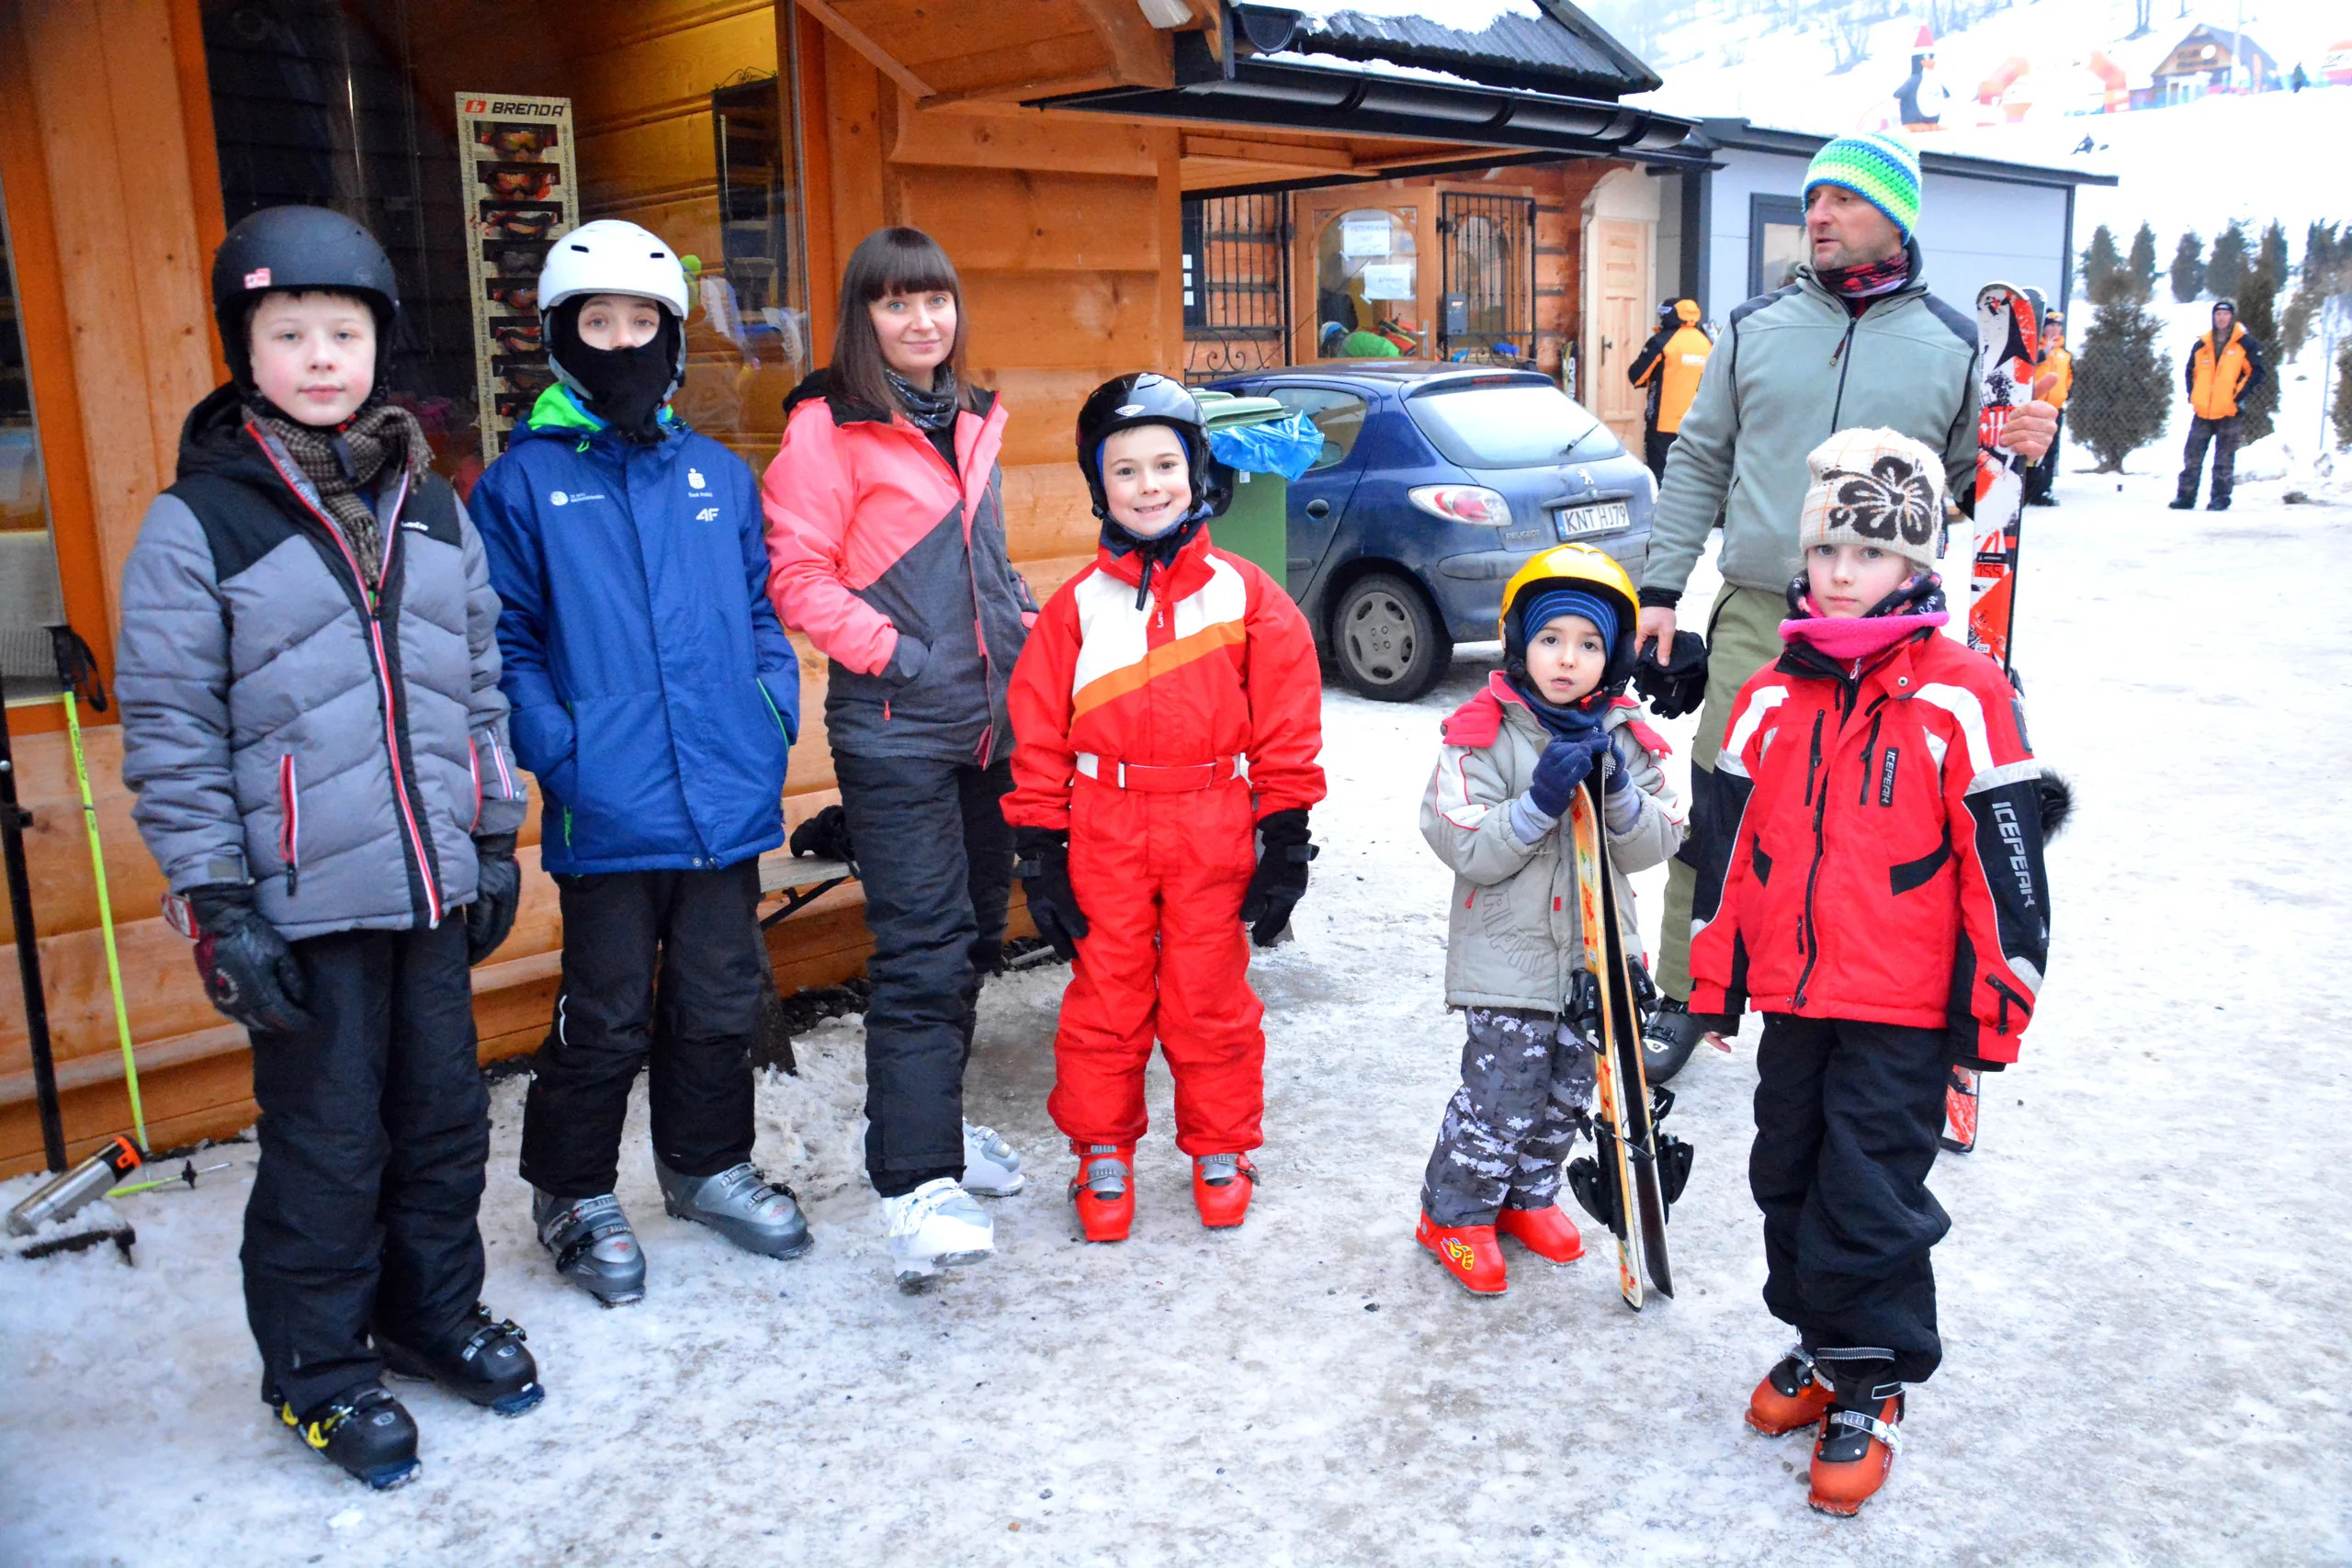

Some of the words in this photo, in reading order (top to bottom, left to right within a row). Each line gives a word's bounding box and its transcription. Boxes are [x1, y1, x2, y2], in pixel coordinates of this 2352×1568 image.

[492, 101, 565, 117] BRENDA
[695, 507, 719, 522] 4F
[1565, 508, 1596, 533] KNT
[1598, 504, 1627, 528] HJ79
[1505, 528, 1541, 540] PEUGEOT
[1881, 750, 1897, 805] ICEPEAK
[1991, 801, 2036, 908] ICEPEAK
